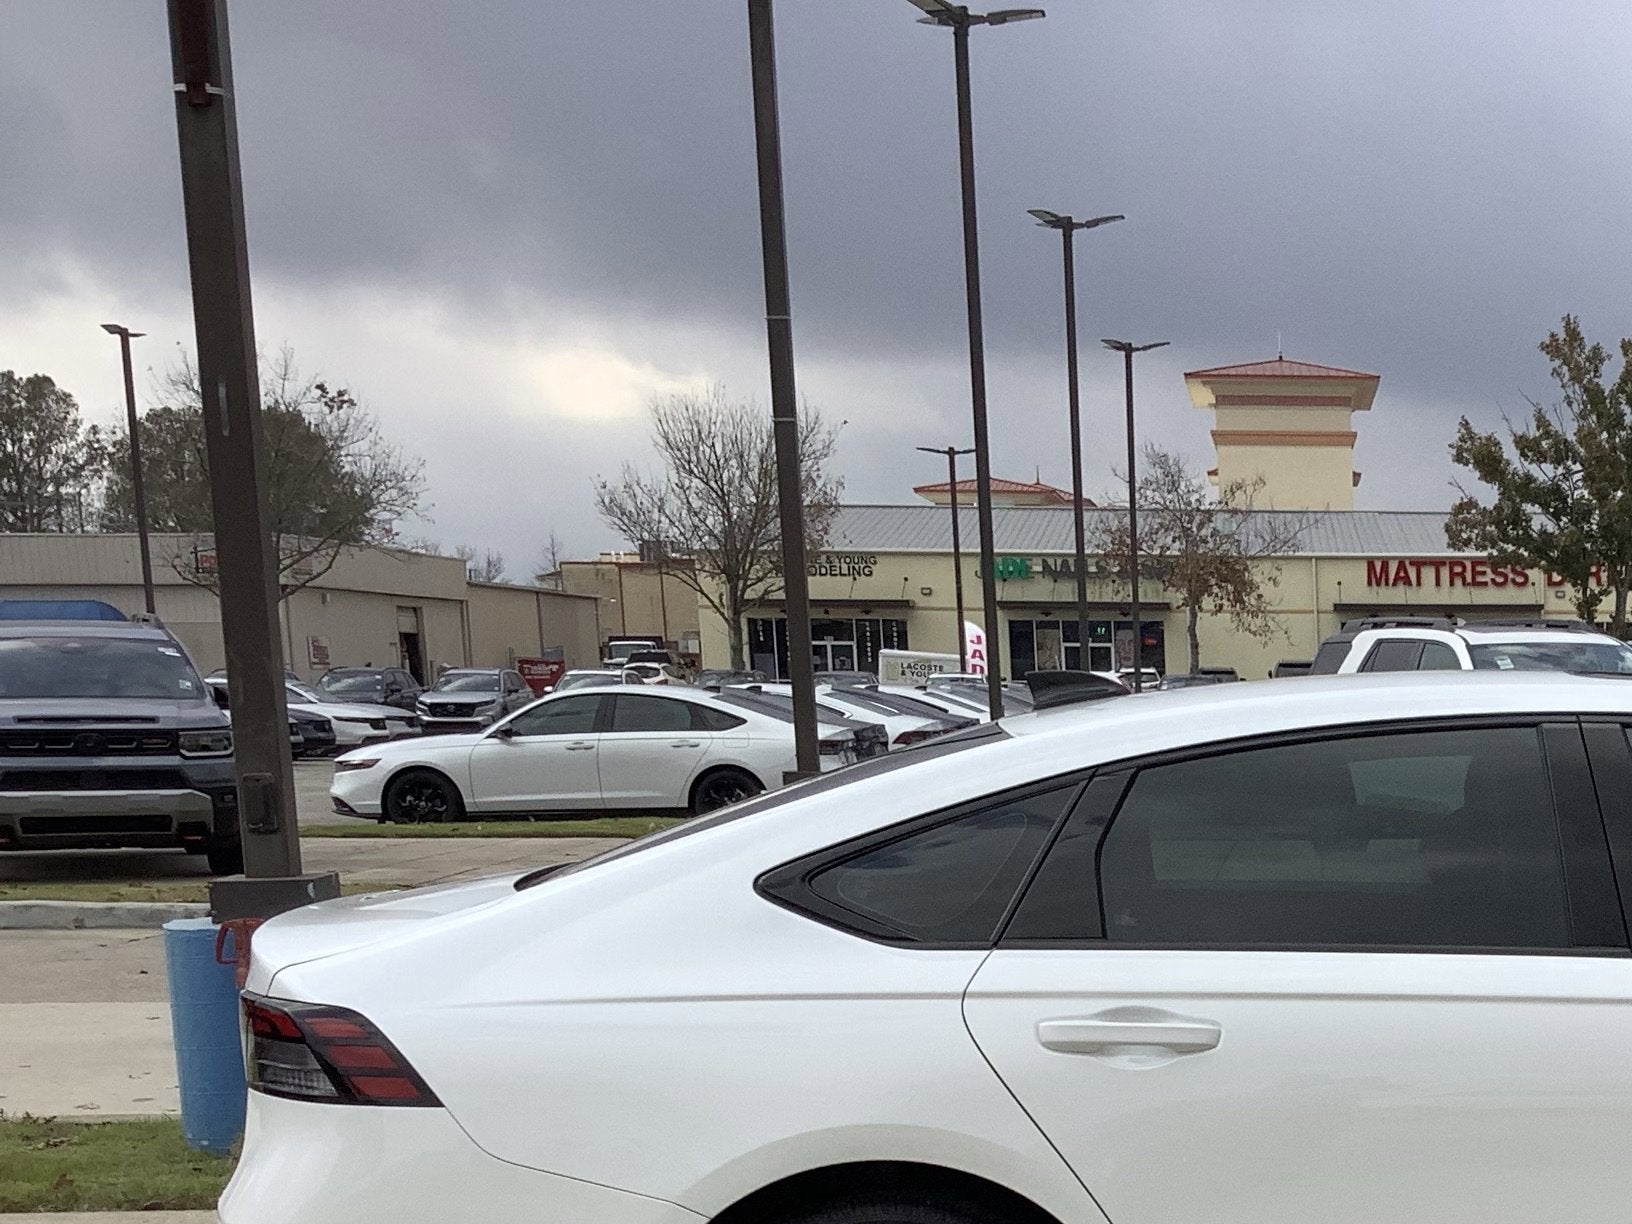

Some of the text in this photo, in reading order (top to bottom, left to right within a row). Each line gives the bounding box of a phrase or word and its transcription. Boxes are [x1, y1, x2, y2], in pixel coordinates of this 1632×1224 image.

[837, 555, 878, 566] YOUNG
[807, 564, 874, 577] ODELING
[1366, 560, 1530, 588] MATTRESS
[900, 662, 944, 672] LACOSTE
